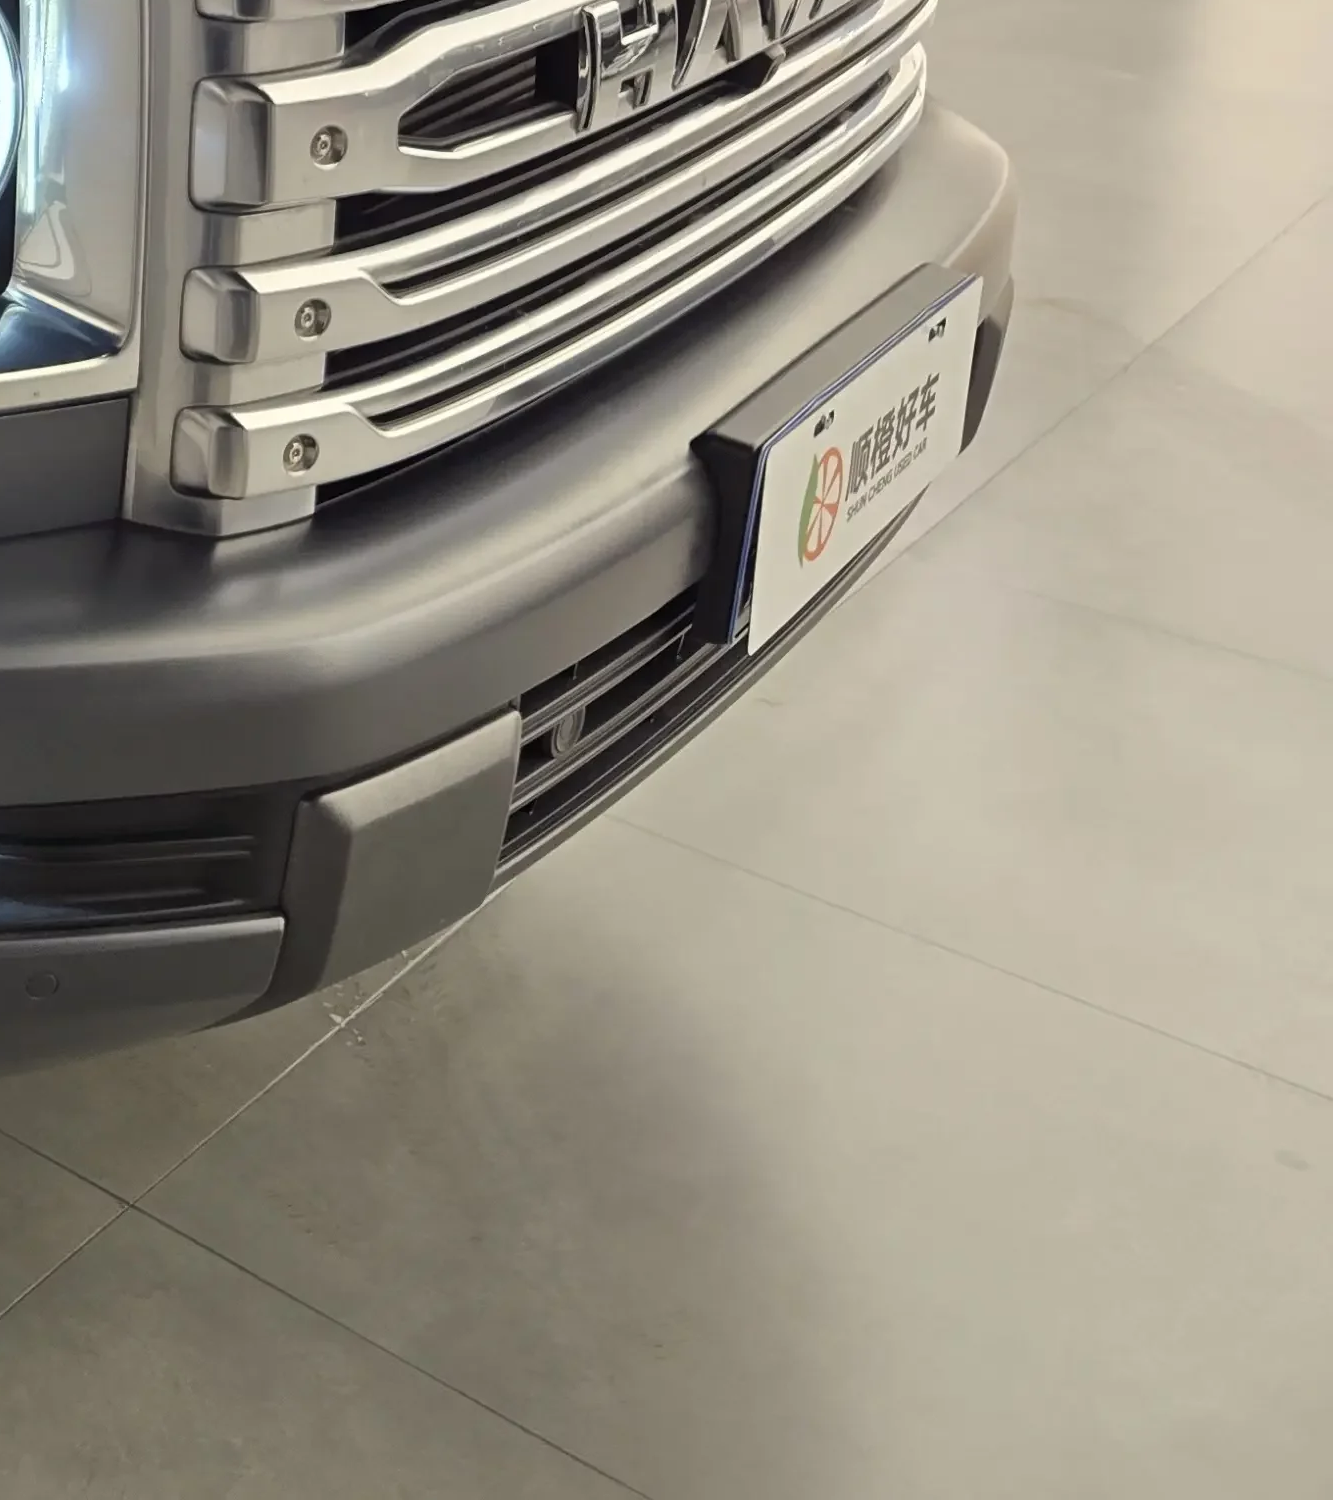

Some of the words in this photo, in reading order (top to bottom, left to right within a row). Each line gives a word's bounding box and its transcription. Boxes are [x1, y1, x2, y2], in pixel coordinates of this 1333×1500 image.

[845, 372, 940, 501] 顺橙好车
[846, 492, 868, 523] SHUN
[868, 469, 893, 503] CHENG
[894, 450, 913, 479] USED
[913, 436, 928, 461] CAR
